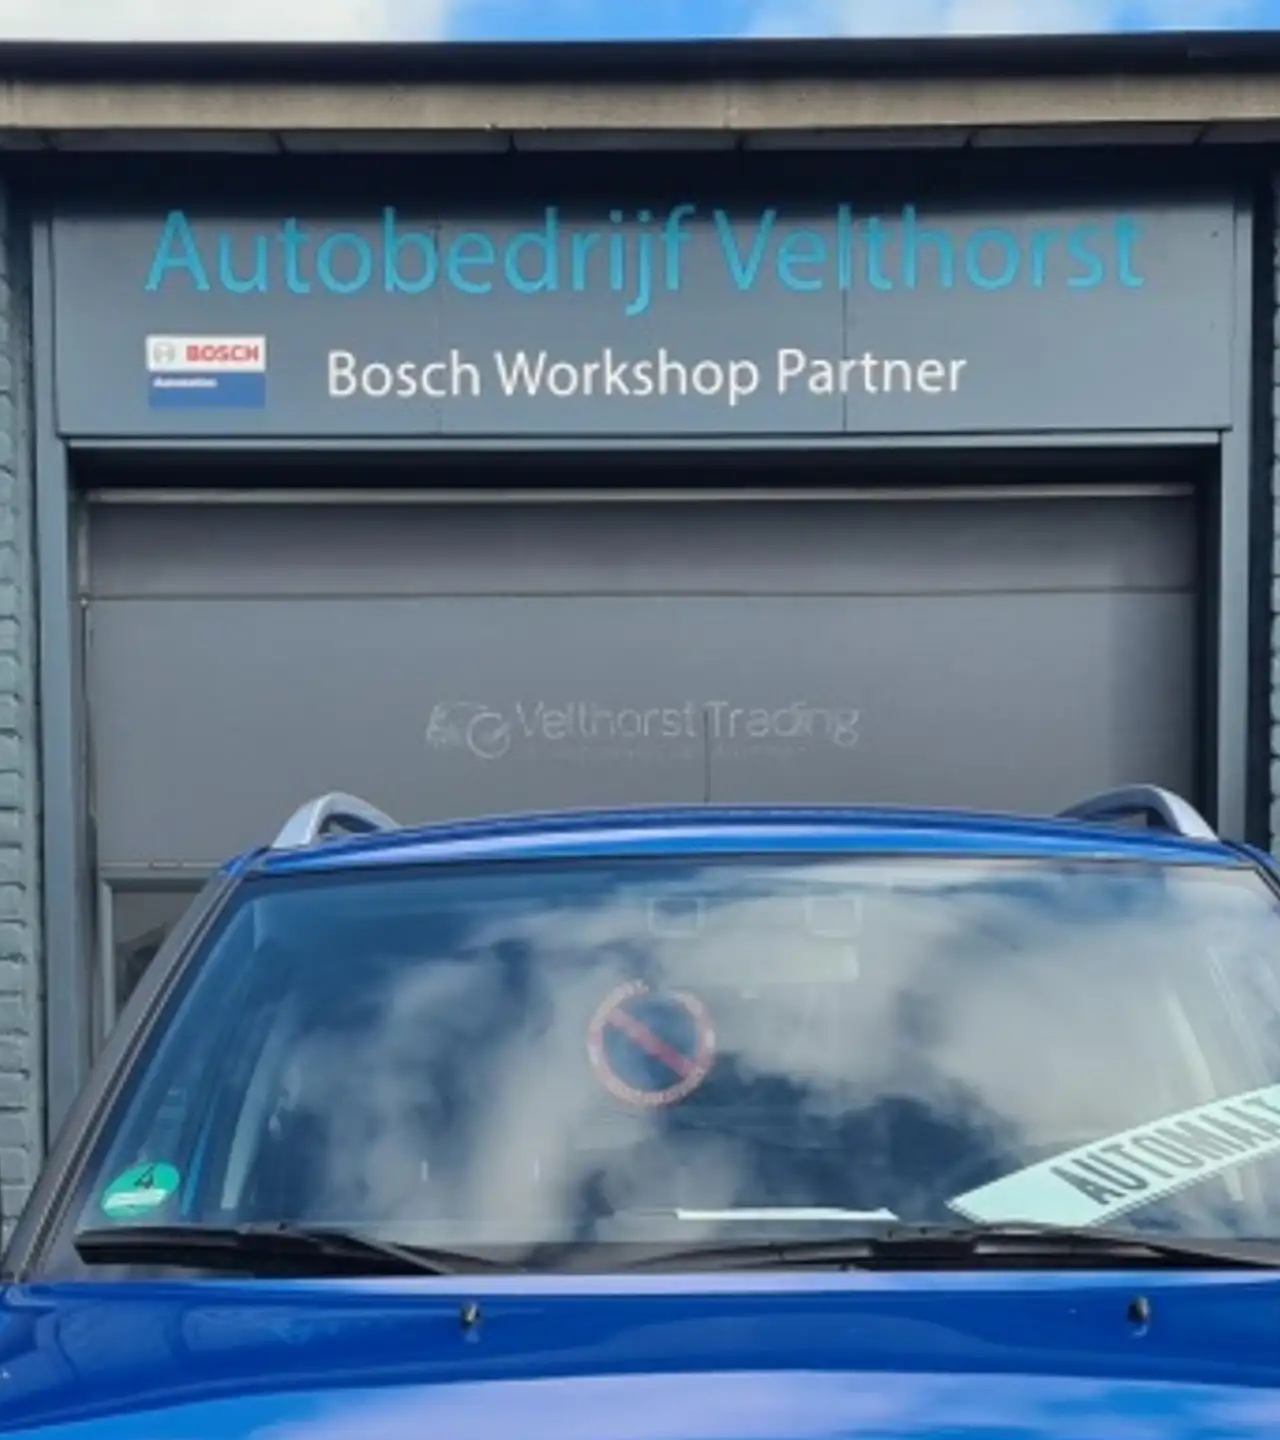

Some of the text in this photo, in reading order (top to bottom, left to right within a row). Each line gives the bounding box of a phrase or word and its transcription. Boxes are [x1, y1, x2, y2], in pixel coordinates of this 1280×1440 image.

[144, 203, 1146, 318] Autobedrijf Velthorst
[185, 343, 260, 363] BOSCH
[326, 346, 968, 408] Bosch Workshop Partner
